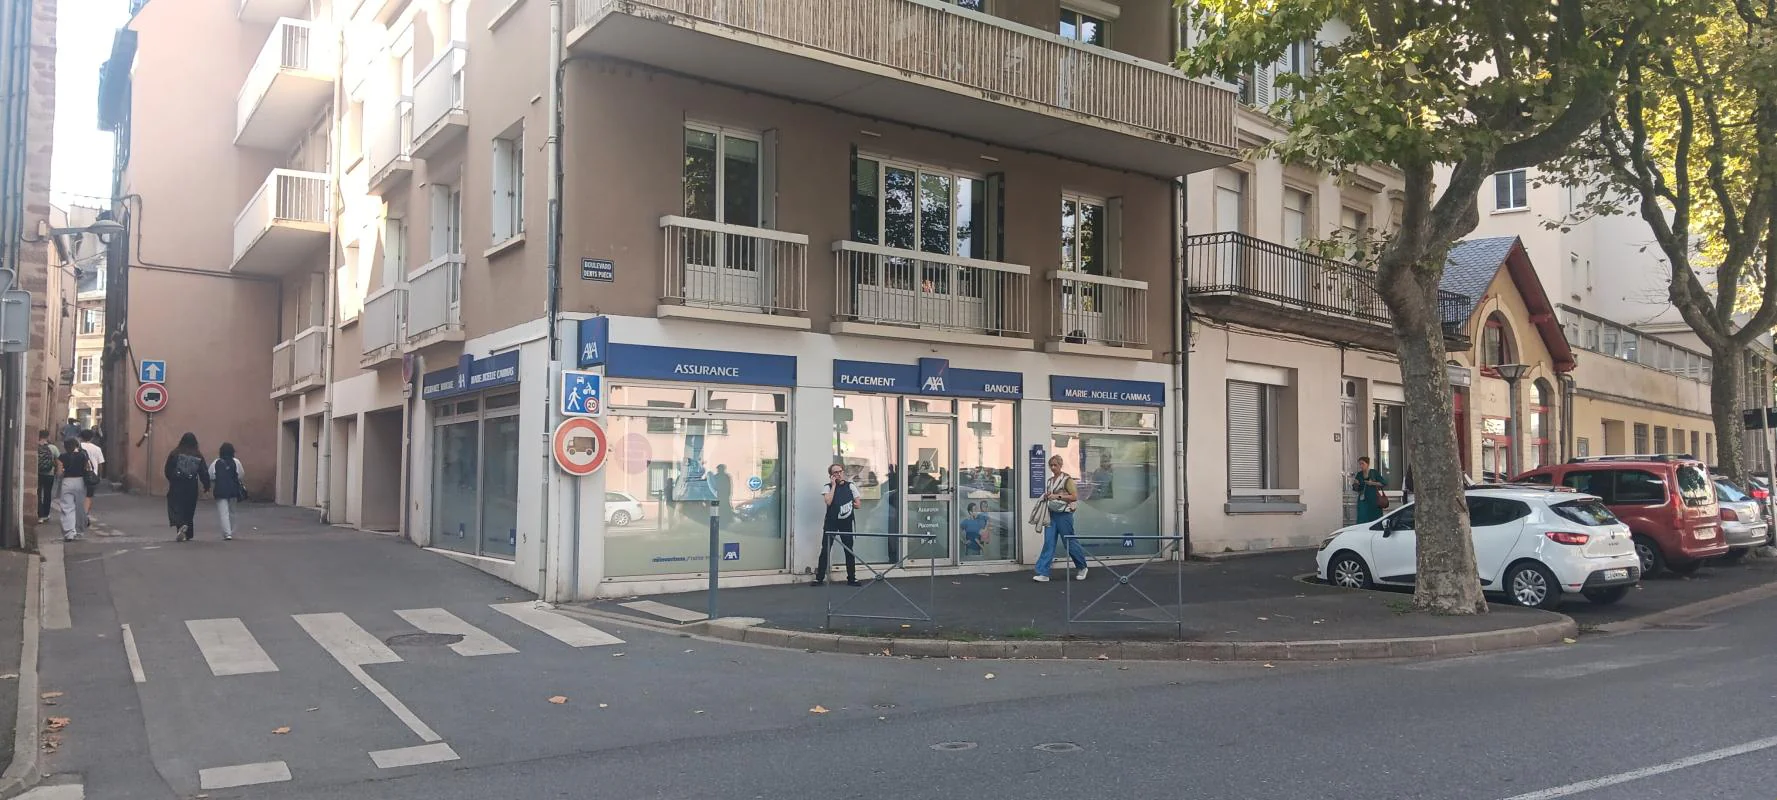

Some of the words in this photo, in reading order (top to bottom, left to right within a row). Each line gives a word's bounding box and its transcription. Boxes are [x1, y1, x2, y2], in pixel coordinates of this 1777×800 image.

[584, 261, 612, 270] BOULEVARD
[582, 341, 598, 360] AXA
[674, 363, 739, 377] ASSURANCE
[841, 374, 896, 387] PLACEMENT
[922, 376, 946, 392] AXA
[984, 383, 1019, 394] BANQUE
[1120, 392, 1151, 402] CAMMAS
[588, 401, 596, 409] 20
